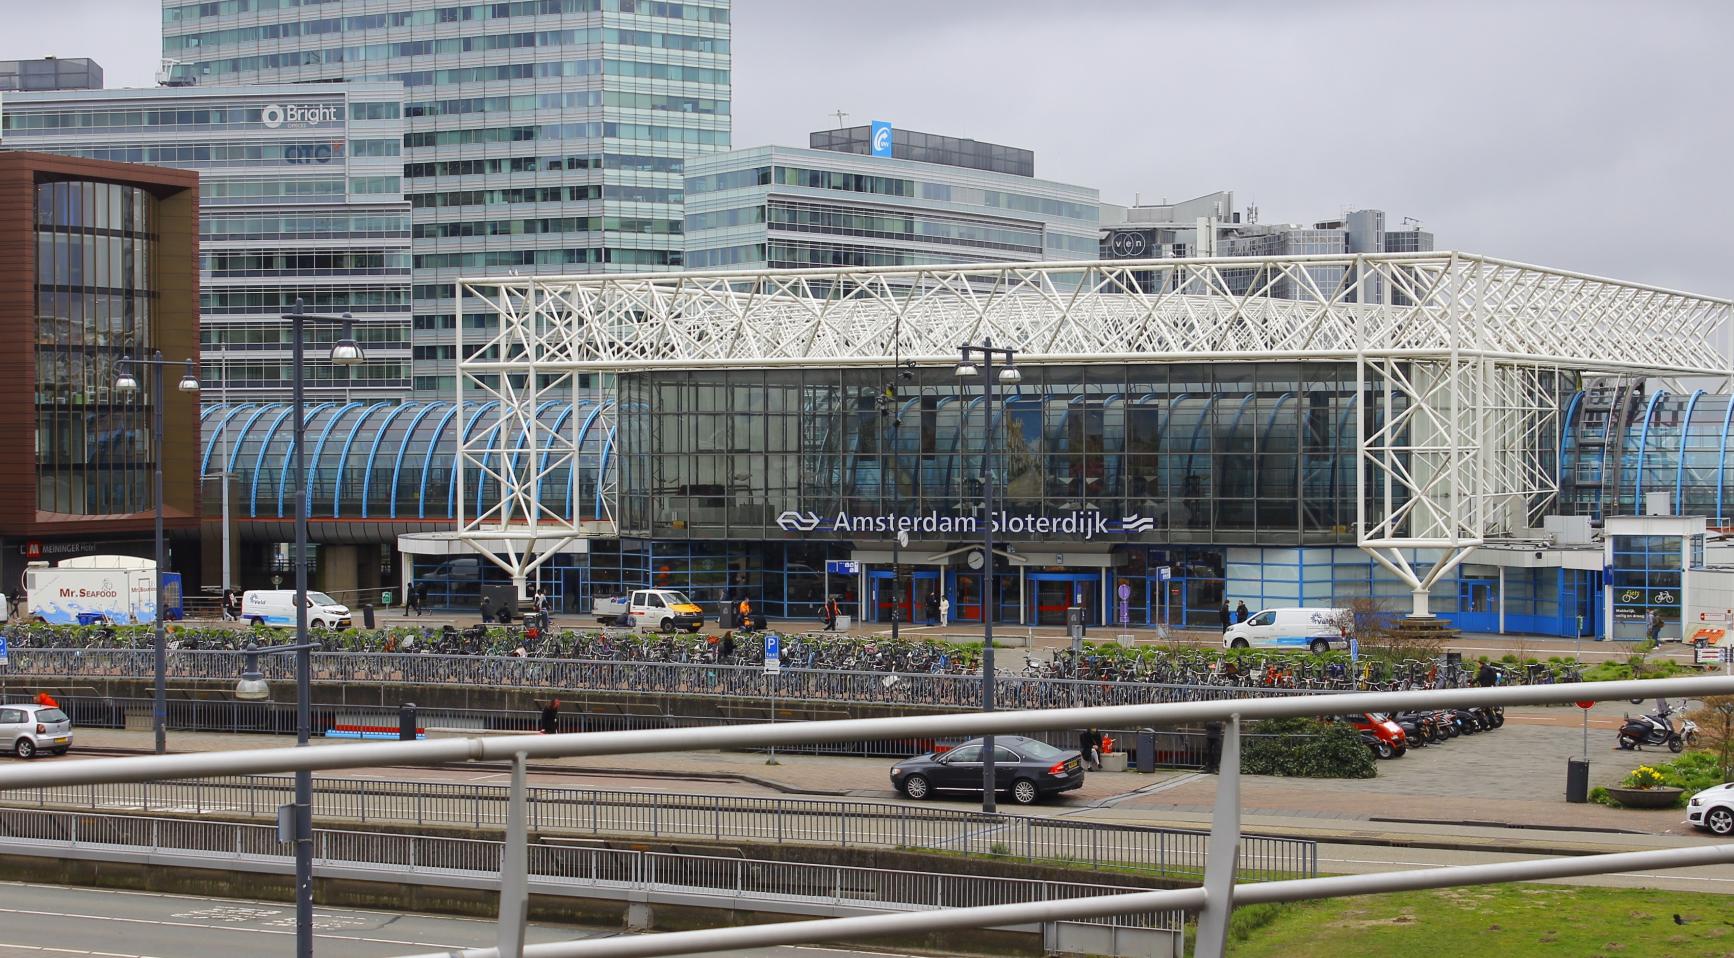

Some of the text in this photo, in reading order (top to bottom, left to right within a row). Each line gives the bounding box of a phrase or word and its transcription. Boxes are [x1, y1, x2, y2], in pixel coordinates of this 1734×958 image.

[287, 104, 337, 126] Bright
[833, 510, 976, 532] Amsterdam
[991, 511, 1109, 540] Sloterdijk
[42, 544, 80, 553] MEININGER
[768, 638, 775, 649] P
